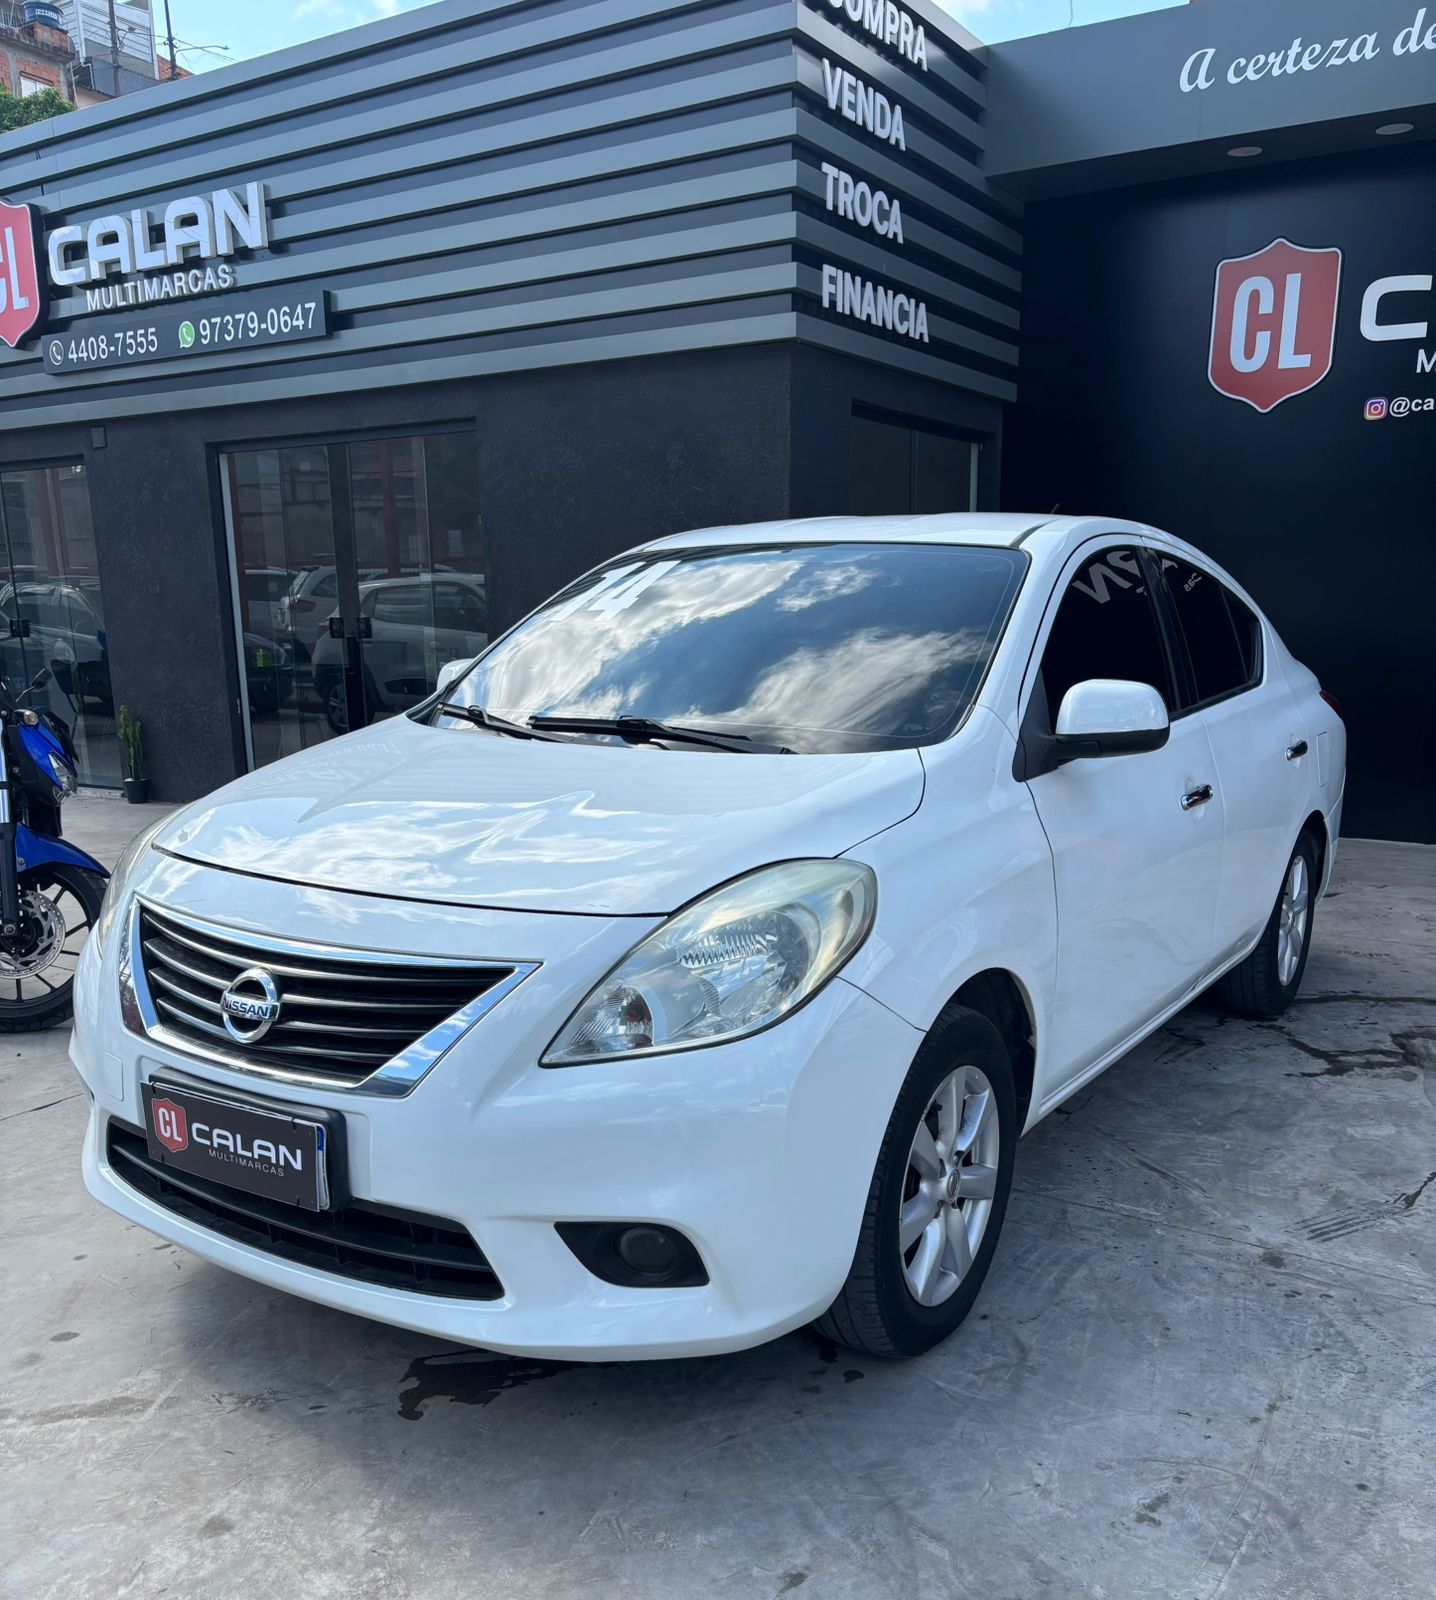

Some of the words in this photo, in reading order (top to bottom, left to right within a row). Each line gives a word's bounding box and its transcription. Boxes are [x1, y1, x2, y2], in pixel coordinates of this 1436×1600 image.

[1180, 48, 1216, 93] A
[1226, 32, 1380, 85] certeza
[822, 58, 906, 151] VENDA
[821, 162, 904, 244] TROCA
[48, 181, 268, 286] CALAN
[86, 264, 236, 311] MULTIMARCAS
[822, 264, 929, 343] FINANCIA
[68, 327, 158, 363] 4408-7555
[200, 302, 316, 344] 97379-0647
[1230, 273, 1311, 373] CL
[549, 560, 682, 621] 14
[223, 994, 270, 1018] NISSAN
[158, 1107, 183, 1142] CL
[192, 1122, 302, 1171] CALAN
[208, 1149, 285, 1177] MULTIMARCAS
